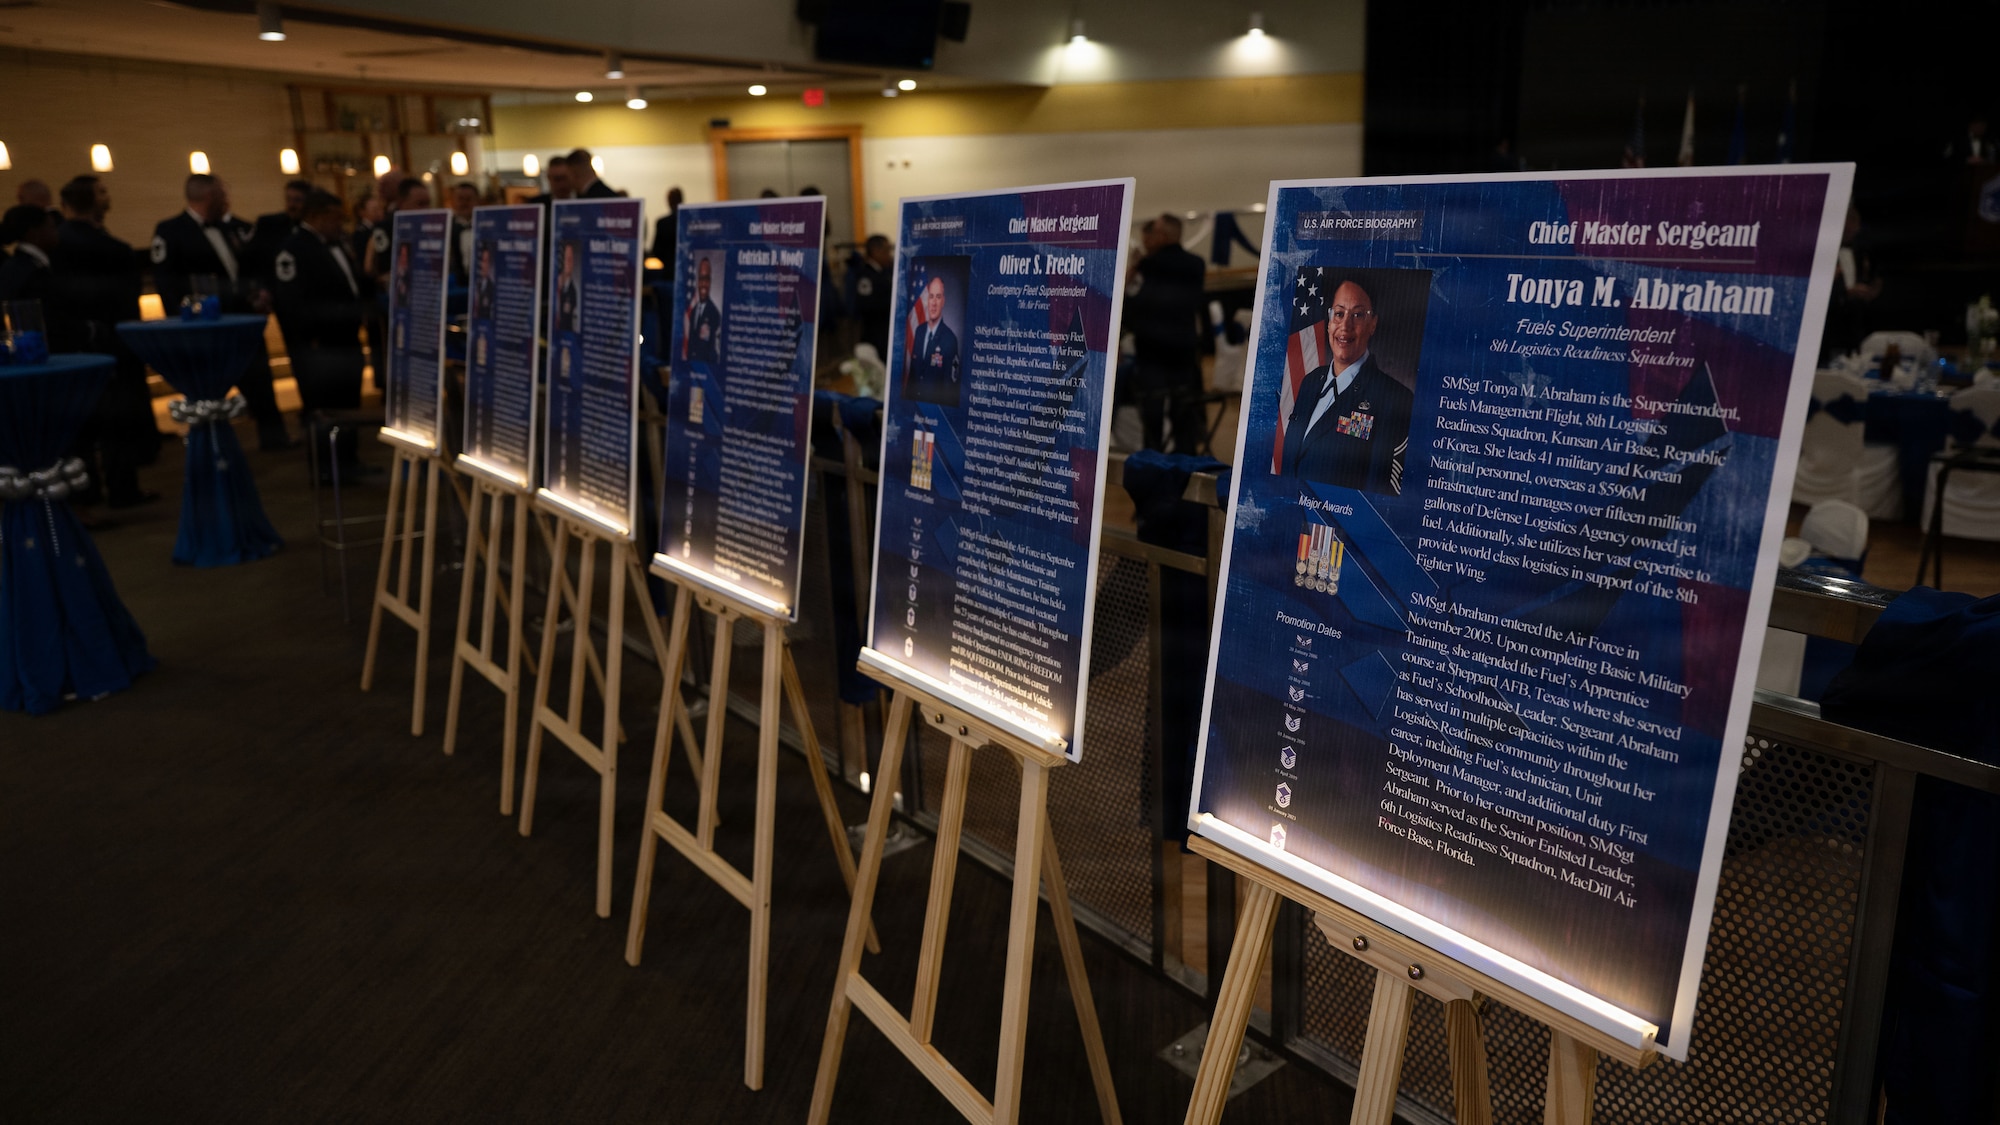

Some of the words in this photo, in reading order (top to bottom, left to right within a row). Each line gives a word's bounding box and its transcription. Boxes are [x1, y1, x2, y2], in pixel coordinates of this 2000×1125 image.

[749, 222, 763, 234] Chief
[763, 222, 781, 234] Master
[780, 221, 805, 235] Sergeant
[1008, 217, 1029, 233] Chief
[1029, 216, 1057, 232] Master
[1059, 214, 1099, 233] Sergeant
[1303, 218, 1319, 229] U.S.
[1319, 217, 1334, 229] AIR
[1335, 218, 1364, 229] FORCE
[1363, 217, 1417, 230] BIOGRAPHY
[1528, 220, 1578, 244] Chief
[1581, 220, 1652, 245] Master
[1656, 220, 1760, 250] Sergeant
[999, 255, 1031, 274] Oliver
[1033, 254, 1042, 274] S.
[1045, 254, 1084, 274] Freche
[987, 284, 1022, 297] Contingency
[1022, 284, 1038, 296] Fleet
[1038, 285, 1087, 298] Superintendent
[1506, 273, 1584, 309] Tonya
[1590, 276, 1620, 307] M.
[1629, 277, 1774, 315] Abraham
[1489, 338, 1509, 352] 8th
[1509, 339, 1562, 358] Logistics
[1562, 343, 1627, 362] Readiness
[1627, 348, 1695, 367] Squadron
[1516, 318, 1556, 336] Fuels
[1558, 320, 1676, 344] Superintendent
[1439, 395, 1468, 411] Fuels
[1469, 399, 1543, 420] Management
[1545, 407, 1583, 427] Flight,
[1585, 412, 1606, 428] 8th
[1608, 415, 1667, 435] Logistics
[1441, 375, 1480, 395] SMSgt
[1482, 379, 1518, 398] Tonya
[1519, 383, 1537, 398] M.
[1539, 385, 1597, 404] Abraham
[1598, 395, 1610, 406] is
[1612, 392, 1633, 408] the
[1634, 395, 1740, 424] Superintendent,
[1432, 436, 1447, 449] of
[1446, 437, 1481, 455] Korea.
[1483, 442, 1506, 458] She
[1507, 445, 1536, 462] leads
[1537, 450, 1552, 465] 41
[1555, 454, 1604, 475] military
[1604, 462, 1630, 476] and
[1632, 463, 1682, 484] Korean
[1436, 415, 1489, 435] Readiness
[1490, 422, 1548, 444] Squadron,
[1550, 430, 1598, 449] Kunsan
[1599, 437, 1623, 452] Air
[1624, 439, 1660, 459] Base,
[1663, 444, 1727, 467] Republic
[1430, 455, 1475, 474] National
[1475, 465, 1532, 485] personnel,
[1534, 475, 1586, 492] overseas
[1587, 483, 1596, 494] a
[1597, 480, 1646, 501] $596M
[1298, 494, 1322, 512] Major
[1321, 499, 1353, 516] Awards
[1427, 474, 1496, 498] infrastructure
[1496, 489, 1519, 502] and
[1520, 494, 1573, 513] manages
[1574, 503, 1604, 517] over
[1605, 505, 1646, 525] fifteen
[1647, 514, 1697, 533] million
[1421, 514, 1443, 530] fuel.
[1445, 519, 1515, 546] Additionally,
[1516, 533, 1537, 549] she
[1539, 539, 1581, 557] utilizes
[1582, 545, 1604, 562] her
[1606, 553, 1631, 568] vast
[1633, 559, 1694, 580] expertise
[1696, 569, 1711, 582] to
[1423, 496, 1461, 513] gallons
[1462, 502, 1477, 515] of
[1476, 504, 1522, 524] Defense
[1524, 512, 1577, 534] Logistics
[1578, 523, 1629, 547] Agency
[1630, 536, 1678, 553] owned
[1676, 544, 1696, 558] jet
[1415, 552, 1453, 572] Fighter
[1455, 561, 1487, 583] Wing.
[1417, 537, 1458, 553] provide
[1459, 545, 1492, 560] world
[1492, 549, 1520, 566] class
[1521, 554, 1569, 577] logistics
[1571, 568, 1583, 580] in
[1585, 572, 1633, 590] support
[1634, 580, 1650, 594] of
[1652, 582, 1673, 599] the
[1675, 587, 1698, 604] 8th
[1275, 610, 1316, 631] Promotion
[1316, 622, 1342, 639] Dates
[1410, 591, 1447, 614] SMSgt
[1447, 601, 1499, 625] Abraham
[1500, 617, 1543, 636] entered
[1544, 625, 1563, 641] the
[1564, 630, 1587, 646] Air
[1588, 635, 1624, 656] Force
[1626, 648, 1639, 660] in
[1405, 626, 1450, 656] Training,
[1451, 643, 1470, 658] she
[1471, 651, 1518, 672] attended
[1519, 661, 1538, 677] the
[1578, 678, 1649, 708] Apprentice
[1407, 610, 1463, 635] November
[1463, 625, 1493, 644] 2005.
[1496, 633, 1528, 654] Upon
[1530, 646, 1598, 675] completing
[1600, 660, 1636, 682] Basic
[1638, 670, 1692, 699] Military
[1398, 670, 1410, 680] as
[1444, 680, 1515, 713] Schoolhouse
[1514, 702, 1557, 727] Leader.
[1560, 715, 1614, 744] Sergeant
[1616, 733, 1679, 763] Abraham
[1401, 652, 1435, 668] course
[1435, 661, 1446, 671] at
[1447, 658, 1498, 691] Sheppard
[1499, 678, 1531, 699] AFB,
[1534, 686, 1570, 708] Texas
[1572, 700, 1611, 720] where
[1612, 710, 1635, 727] she
[1636, 720, 1681, 740] served
[1378, 815, 1406, 836] Force
[1406, 827, 1434, 851] Base,
[1436, 839, 1475, 866] Florida.
